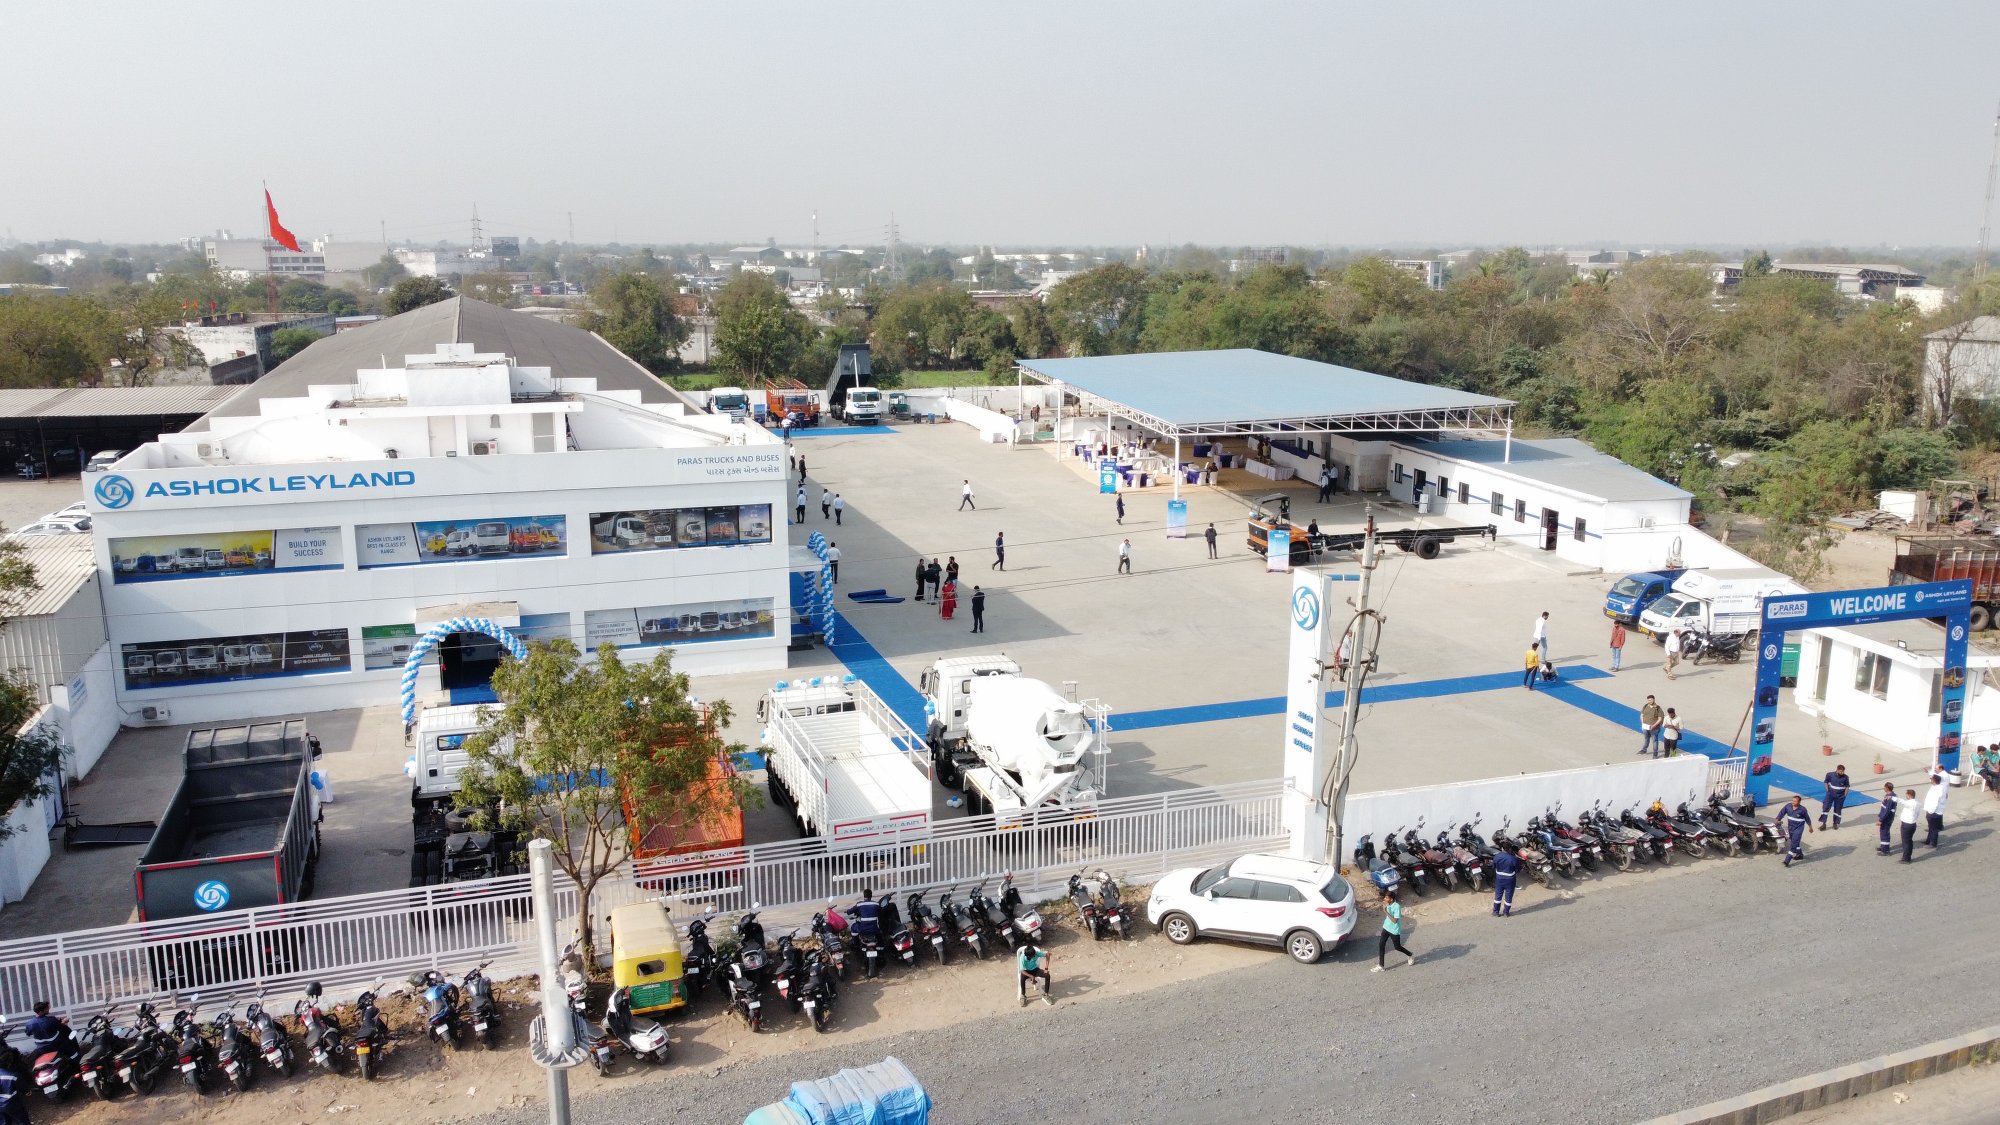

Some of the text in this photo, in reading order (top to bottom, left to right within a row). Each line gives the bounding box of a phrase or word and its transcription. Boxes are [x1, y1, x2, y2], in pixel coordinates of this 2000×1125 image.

[677, 454, 780, 465] PARAS TRUCKS AND BUSES
[145, 470, 416, 498] ASHOK LEYLAND
[288, 539, 327, 549] BUILD YOUR
[293, 549, 324, 557] SUCCESS
[1779, 603, 1805, 611] PARAS
[1830, 592, 1907, 615] WELCOME
